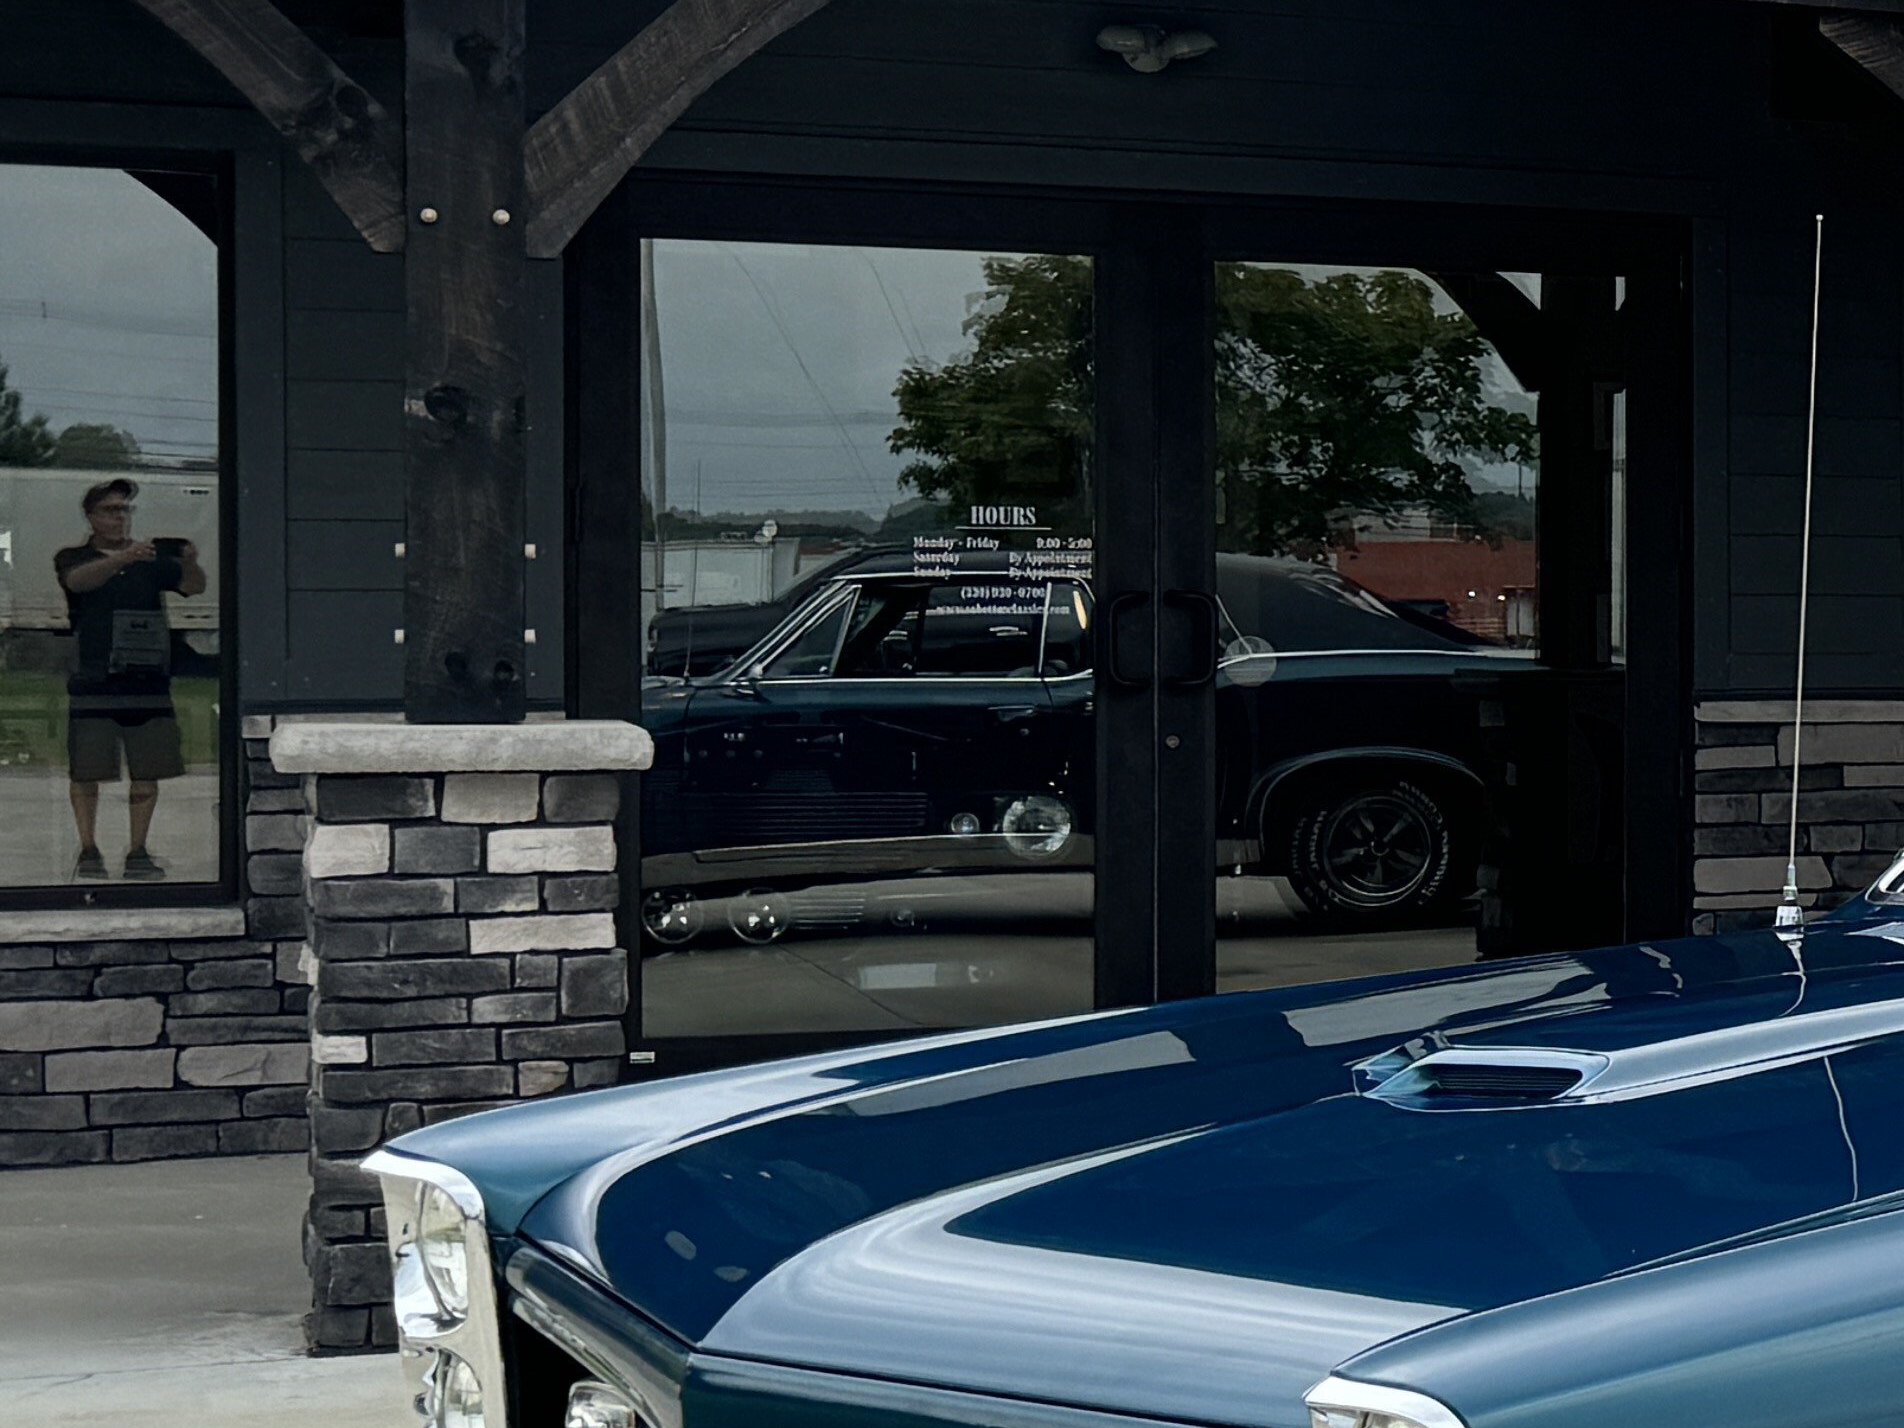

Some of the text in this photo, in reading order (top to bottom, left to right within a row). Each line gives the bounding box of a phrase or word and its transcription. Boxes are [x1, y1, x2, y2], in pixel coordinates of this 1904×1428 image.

[970, 505, 1037, 525] HOURS
[913, 536, 955, 550] Monday
[966, 536, 1000, 551] Friday
[913, 551, 960, 565] Saturday
